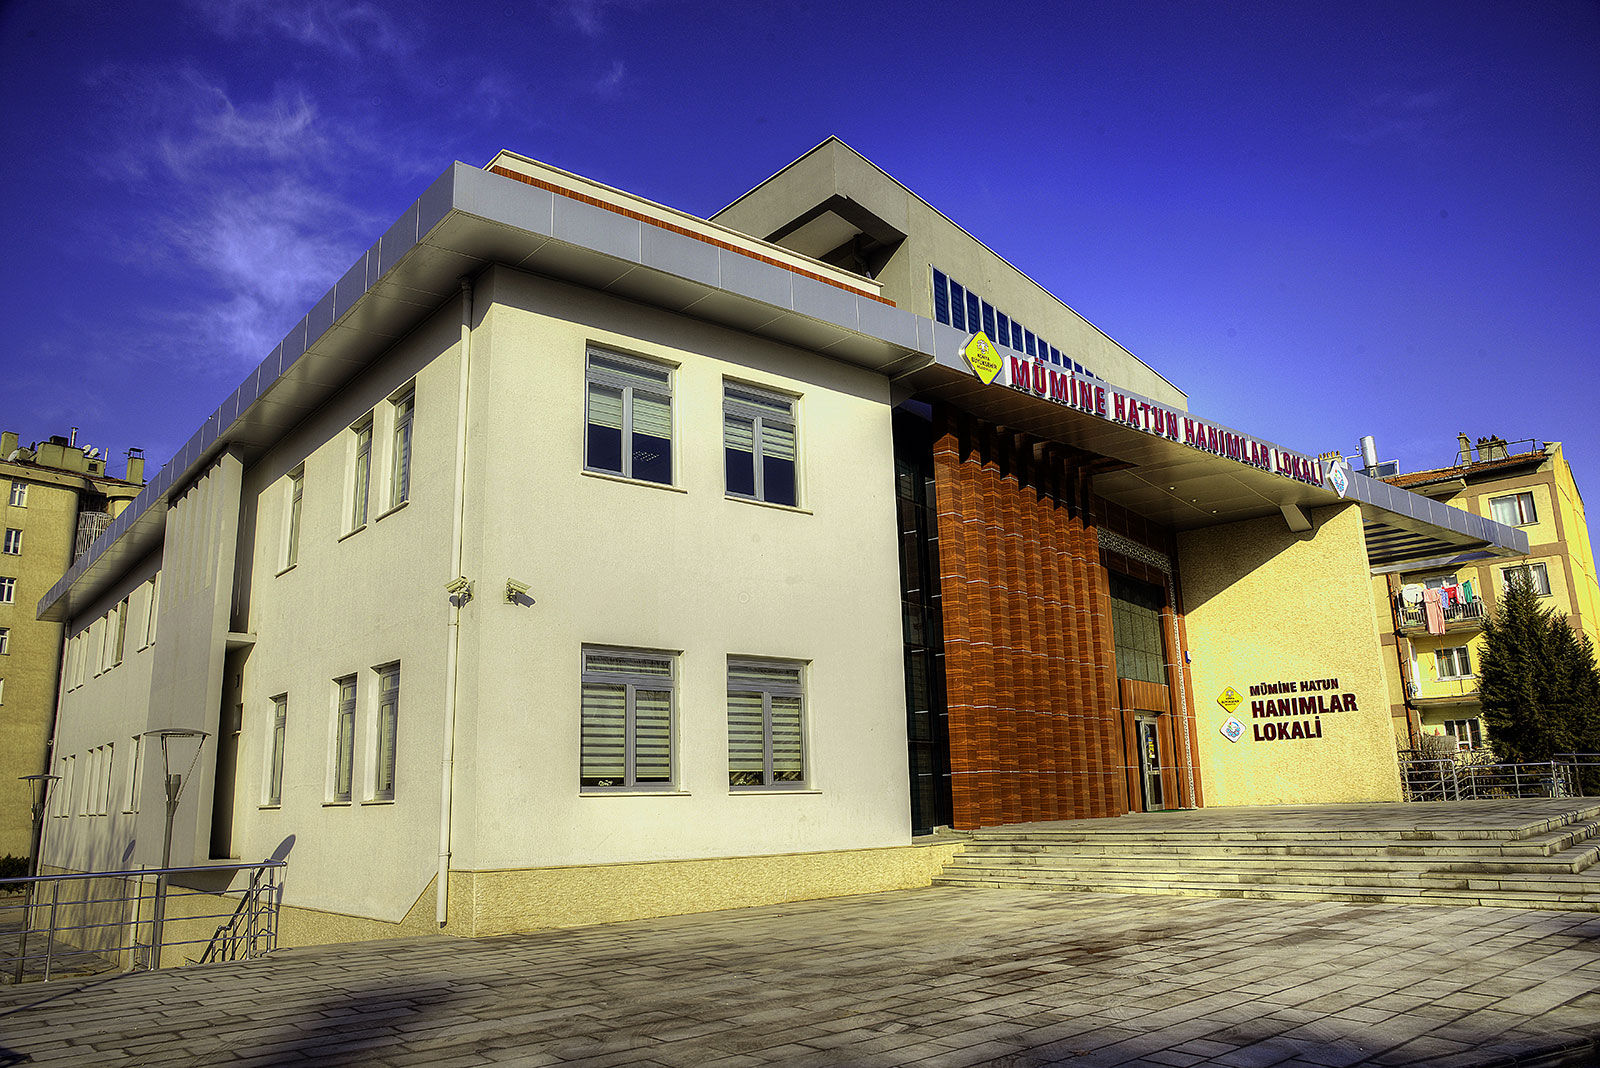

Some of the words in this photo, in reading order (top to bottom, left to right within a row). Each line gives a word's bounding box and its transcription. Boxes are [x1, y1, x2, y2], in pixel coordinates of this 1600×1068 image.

[1010, 355, 1106, 415] MÜMİNE
[1113, 392, 1179, 439] HATUN
[1184, 416, 1271, 469] HANIMLAR
[1274, 448, 1324, 485] LOKALİ
[1250, 681, 1297, 697] MÜMİNE
[1299, 678, 1339, 692] HATUN
[1251, 693, 1358, 718] HANIMLAR
[1253, 716, 1322, 741] LOKALİ
